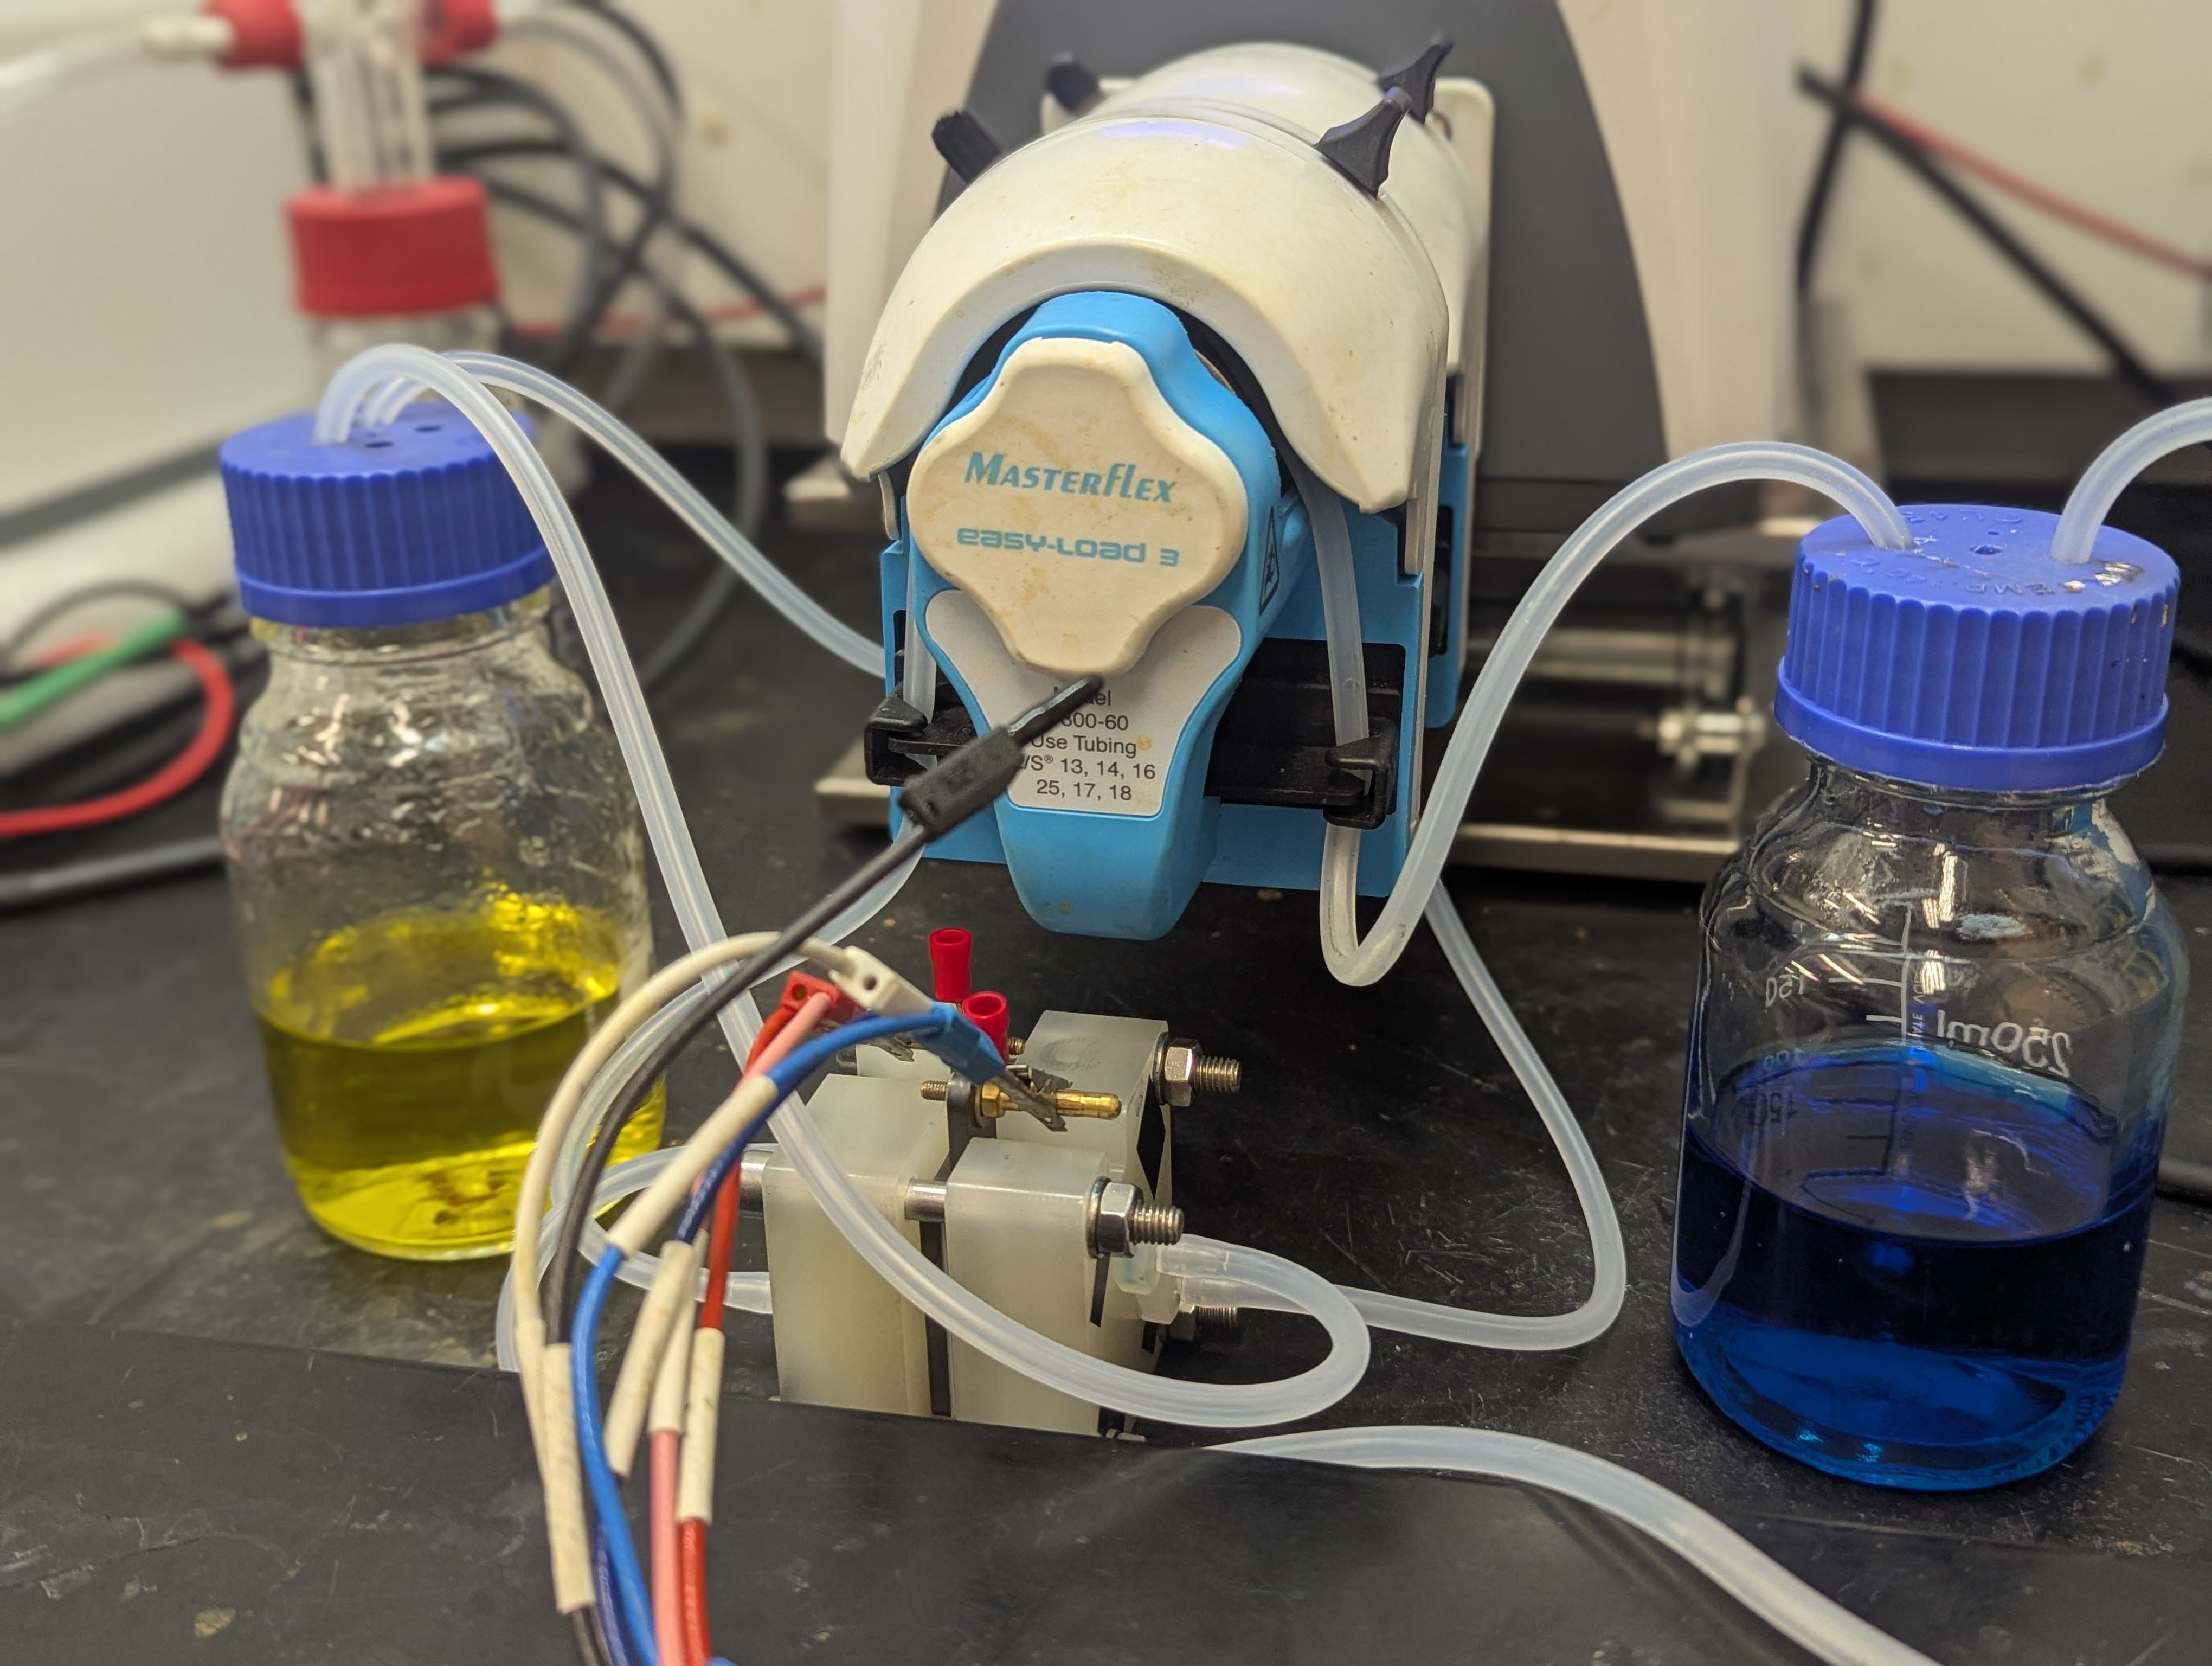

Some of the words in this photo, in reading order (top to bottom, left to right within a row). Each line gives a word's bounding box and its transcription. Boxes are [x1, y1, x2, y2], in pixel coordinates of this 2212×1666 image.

[1160, 548, 1180, 567] 3
[1062, 712, 1129, 731] 800-60
[1031, 735, 1068, 749] Use
[1073, 734, 1137, 759] Tubing
[1020, 754, 1054, 772] /S®
[1060, 758, 1089, 777] 13,
[1097, 761, 1125, 780] 14,
[1133, 763, 1156, 779] 16
[1036, 779, 1065, 798] 25,
[1073, 782, 1102, 801] 17,
[1109, 785, 1132, 801] 18
